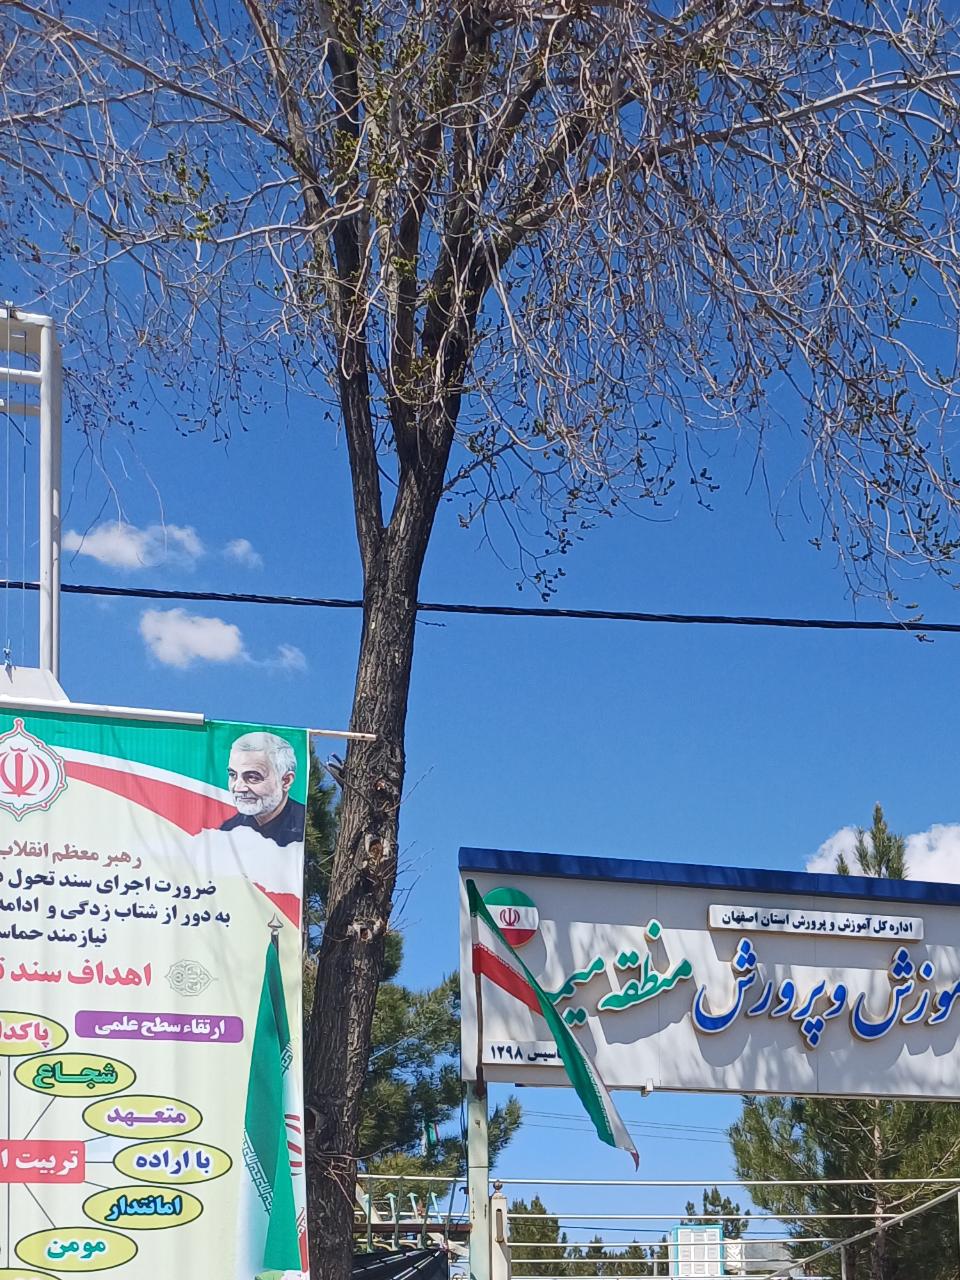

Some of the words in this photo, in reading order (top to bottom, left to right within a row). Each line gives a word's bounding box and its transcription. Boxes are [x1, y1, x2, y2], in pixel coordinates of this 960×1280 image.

[0, 839, 49, 860] انقلاب
[52, 843, 99, 864] معظم
[102, 850, 142, 869] رهبر
[8, 868, 55, 889] تحول
[59, 873, 92, 888] سند
[96, 875, 151, 895] اجرای
[154, 879, 217, 899] ضرورت
[46, 904, 57, 919] و
[60, 900, 111, 922] زدگی
[114, 902, 158, 922] شتاب
[161, 904, 178, 924] از
[180, 909, 211, 926] دور
[215, 910, 231, 927] به
[722, 911, 758, 925] اصفهان
[761, 913, 790, 927] استان
[792, 916, 826, 931] پرورش
[829, 922, 835, 931] و
[838, 917, 872, 933] آموزش
[873, 920, 888, 933] کل
[889, 922, 913, 934] اداره
[47, 927, 107, 947] نیازمند
[10, 961, 62, 983] سند
[67, 958, 152, 986] اهداف
[598, 918, 693, 1011] منطقه
[544, 956, 606, 1027] میم
[691, 937, 826, 1049] پرورش
[824, 981, 848, 1019] و
[94, 1015, 138, 1035] علمی
[141, 1016, 181, 1037] سطح
[184, 1018, 225, 1040] ارتقاء
[32, 1060, 118, 1089] شجاع
[107, 1107, 186, 1127] متعهد
[15, 1149, 79, 1176] تربیت
[136, 1150, 189, 1174] اراده
[196, 1150, 210, 1174] با
[104, 1194, 183, 1221] امانتدار
[47, 1239, 106, 1259] مومن
